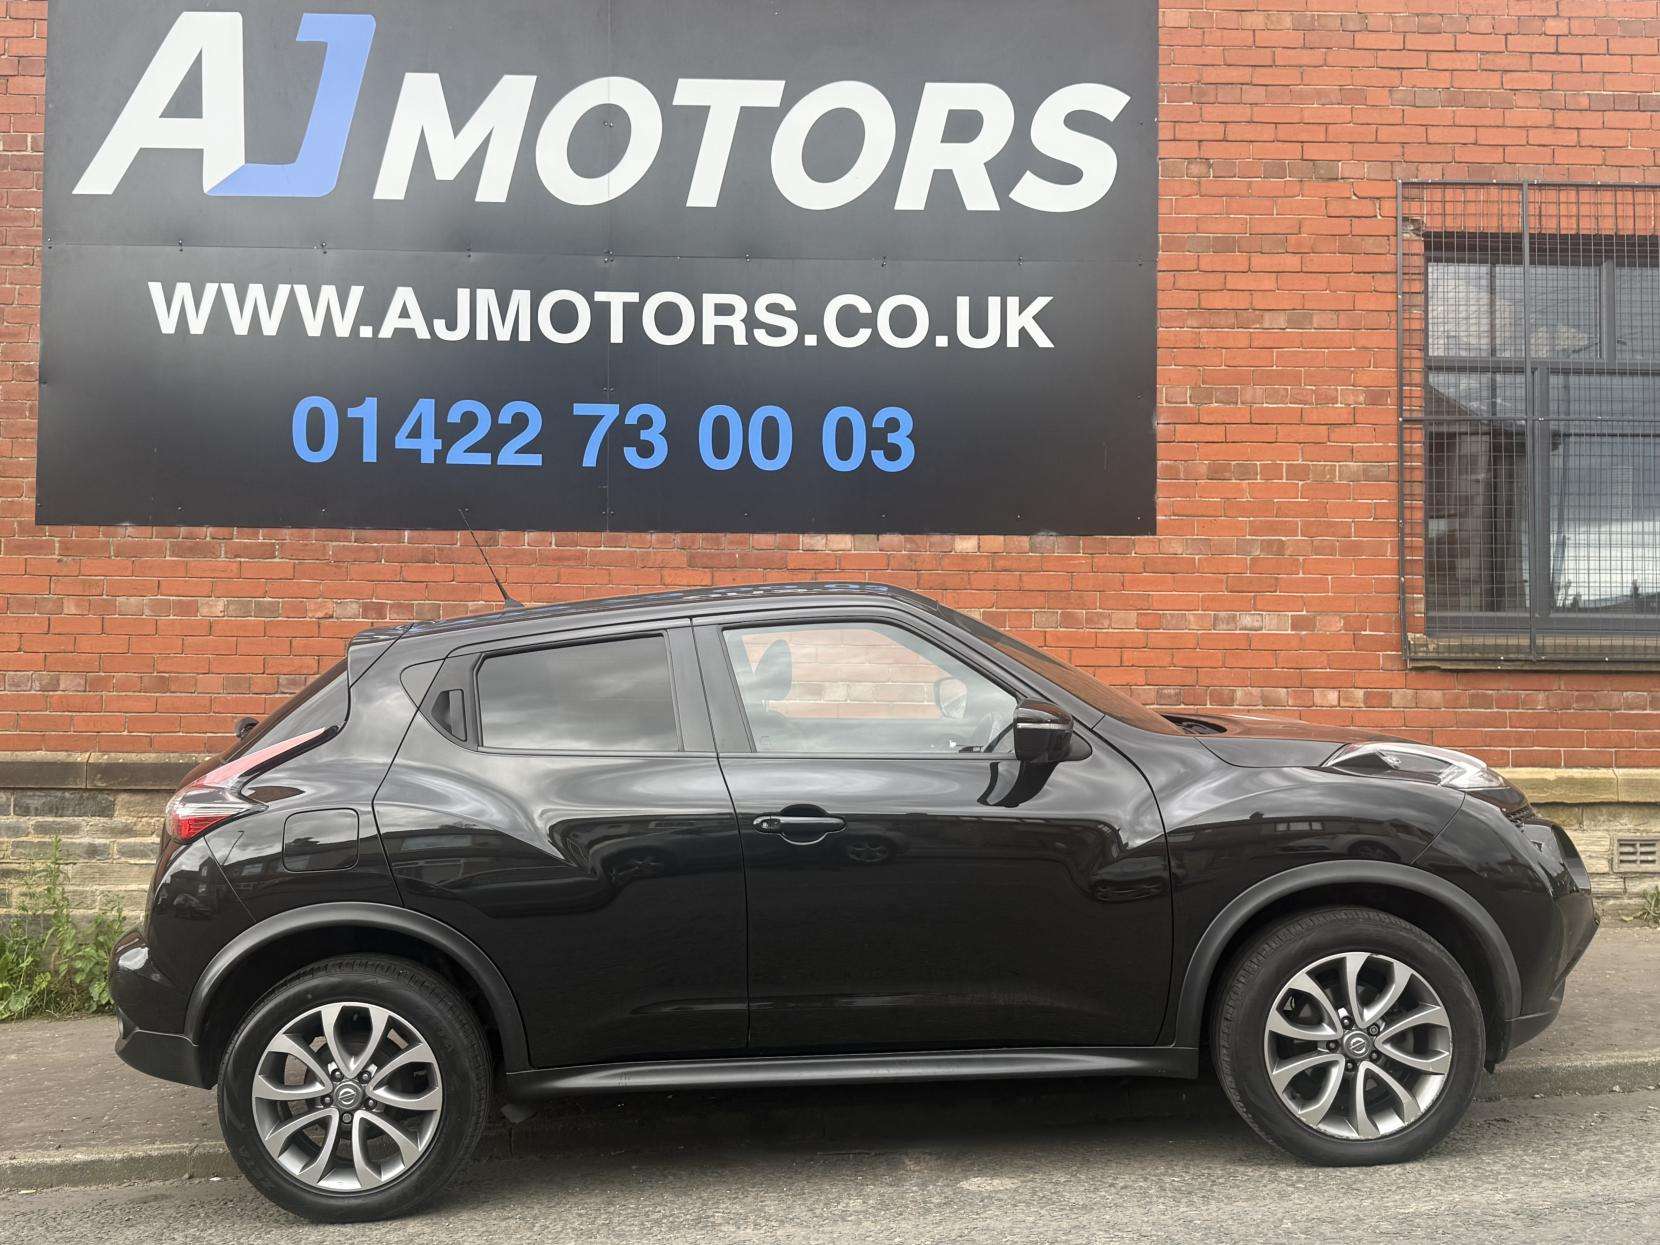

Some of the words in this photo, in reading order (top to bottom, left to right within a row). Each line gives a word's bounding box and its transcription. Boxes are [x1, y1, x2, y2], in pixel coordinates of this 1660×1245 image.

[72, 10, 377, 198] AJ
[372, 71, 1132, 213] MOTORS
[147, 281, 1055, 349] WWW.AJMOTORS.CO.UK
[291, 395, 543, 467] 01422
[572, 402, 669, 470] 73
[698, 404, 793, 472] 00
[821, 405, 916, 473] 03
